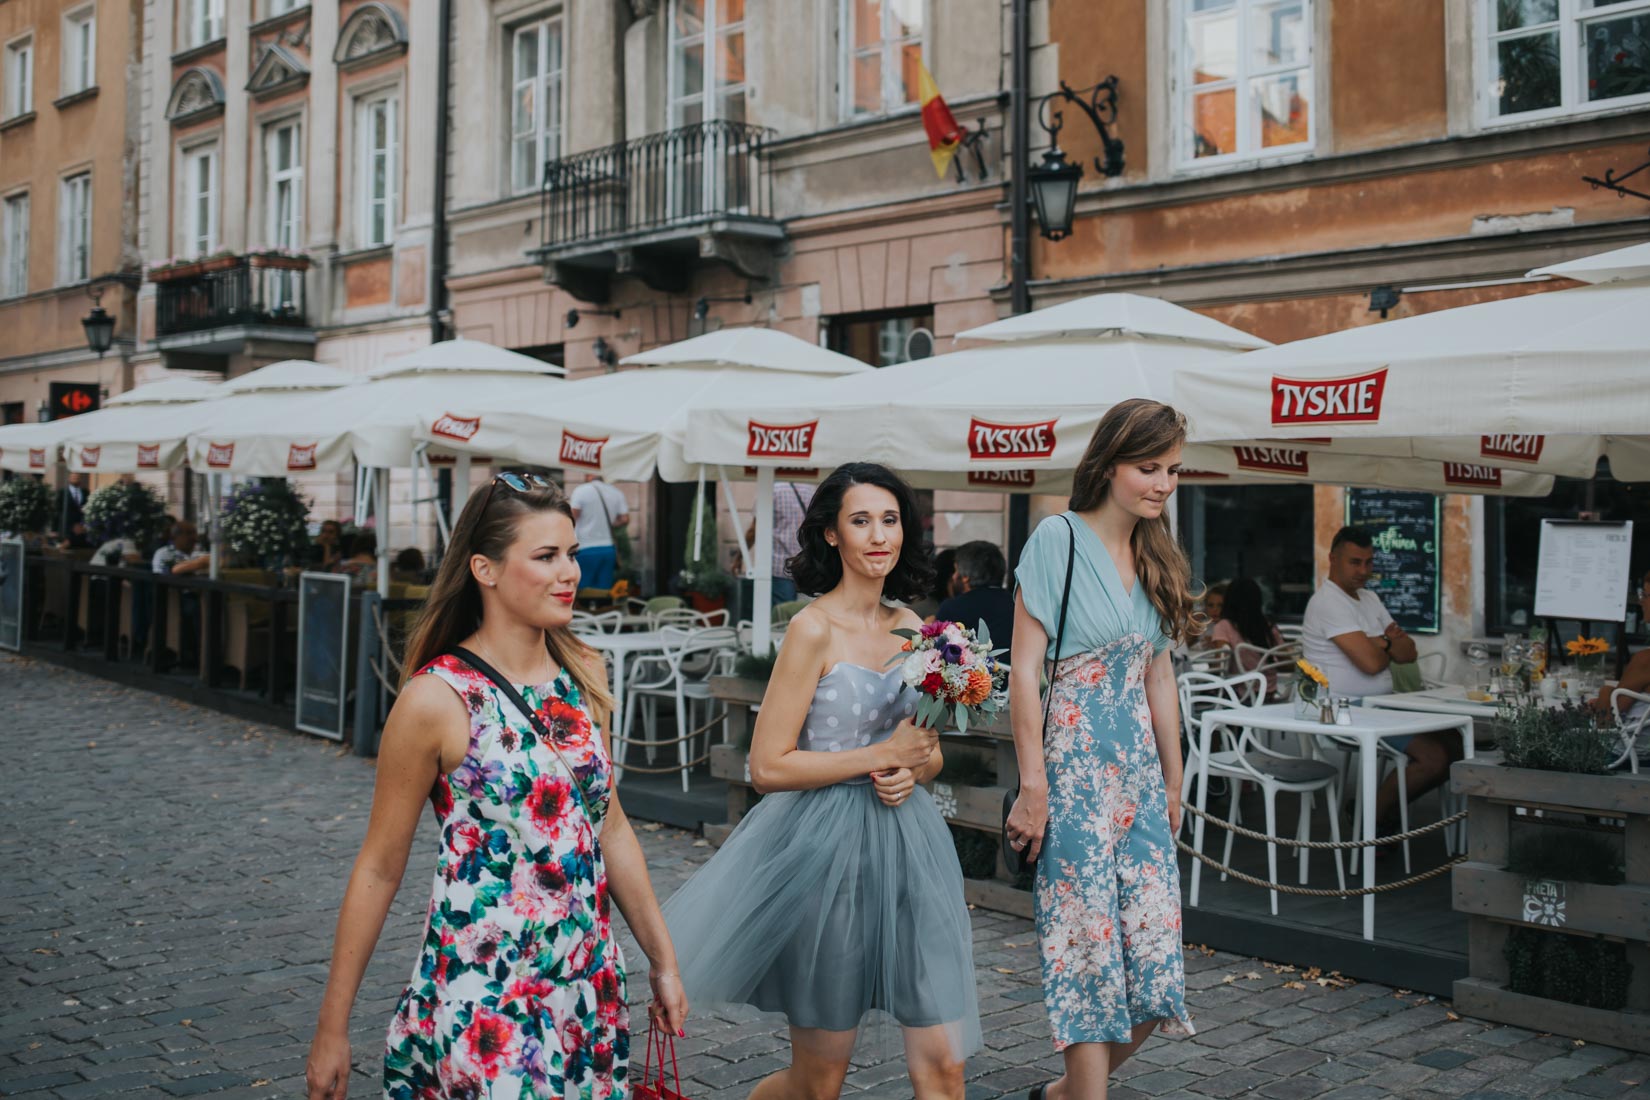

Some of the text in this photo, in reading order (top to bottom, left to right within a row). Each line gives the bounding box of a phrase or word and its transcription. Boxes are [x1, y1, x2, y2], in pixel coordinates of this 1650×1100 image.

[1277, 379, 1377, 417] TYSKIE
[562, 435, 603, 463] TYSKIE
[751, 426, 812, 452] TYSKIE
[974, 424, 1051, 453] TYSKIE
